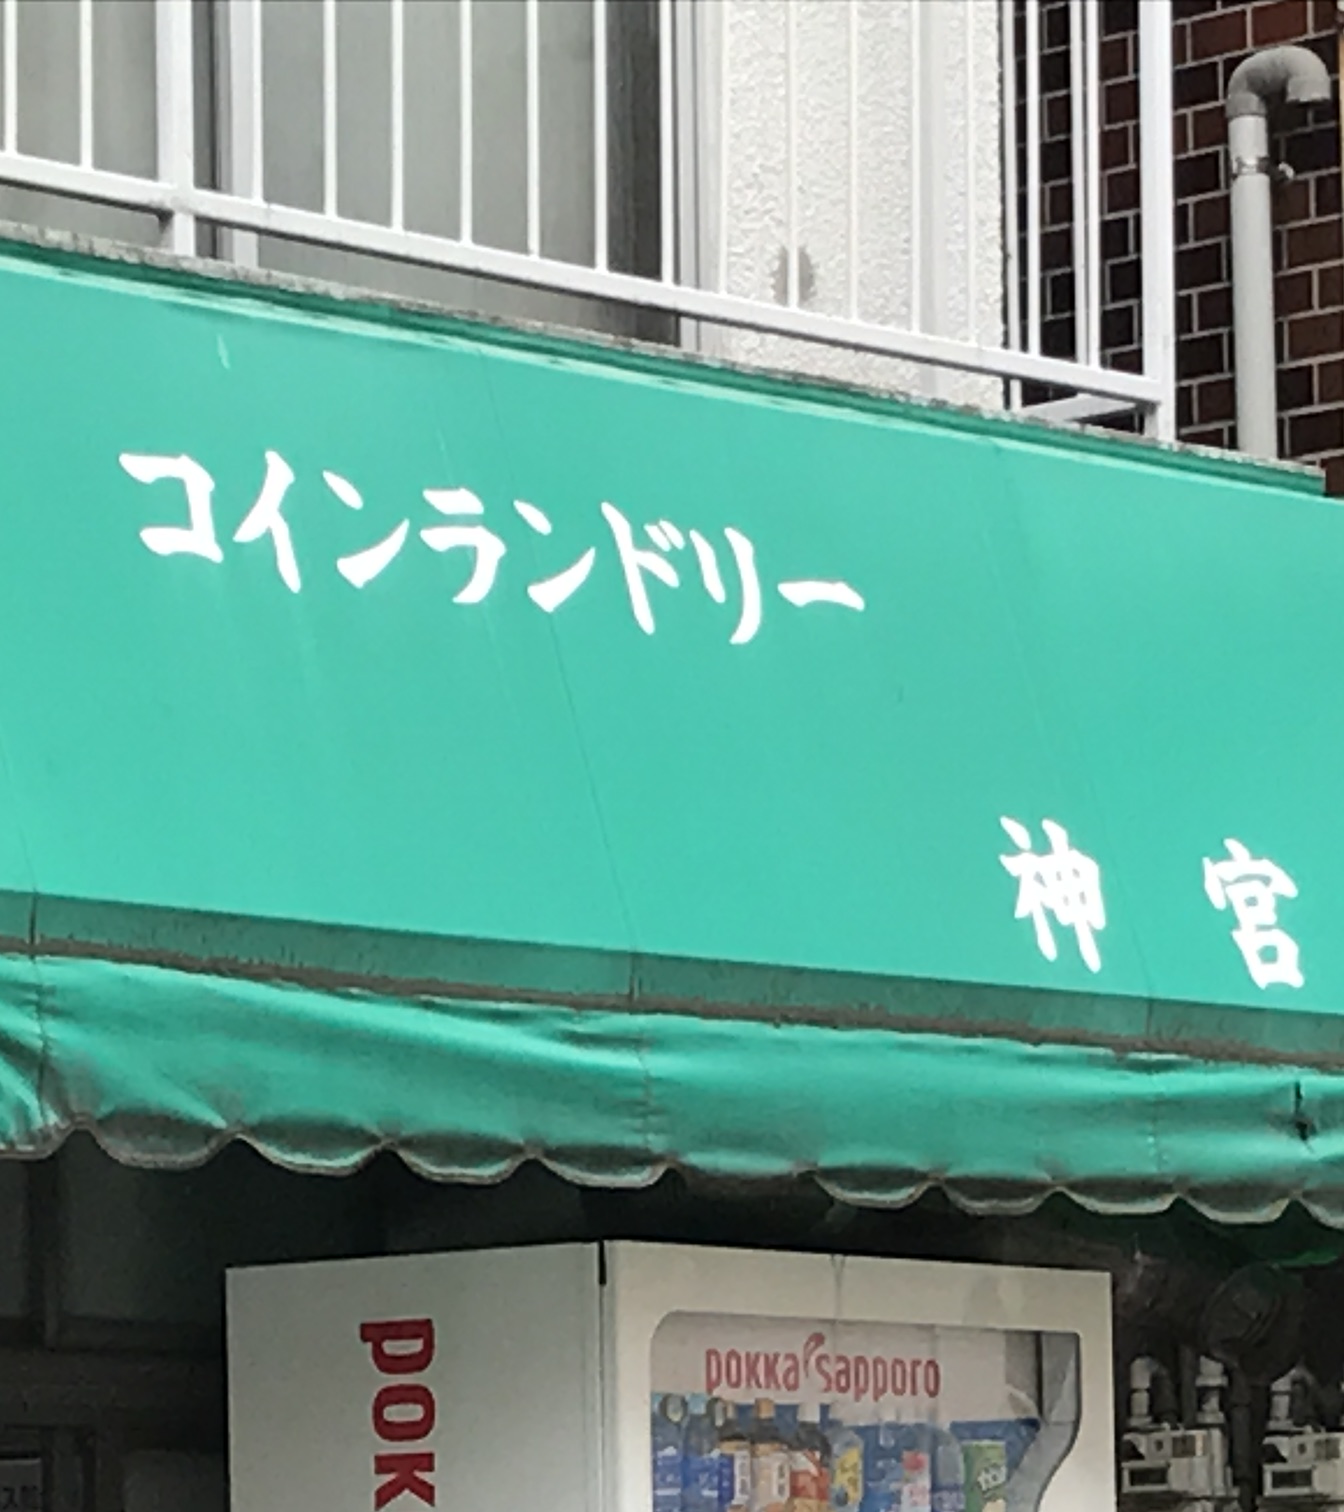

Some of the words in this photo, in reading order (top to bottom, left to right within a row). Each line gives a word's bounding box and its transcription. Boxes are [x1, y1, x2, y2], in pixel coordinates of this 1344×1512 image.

[118, 450, 865, 645] コインランドリー
[999, 815, 1305, 990] 神宮
